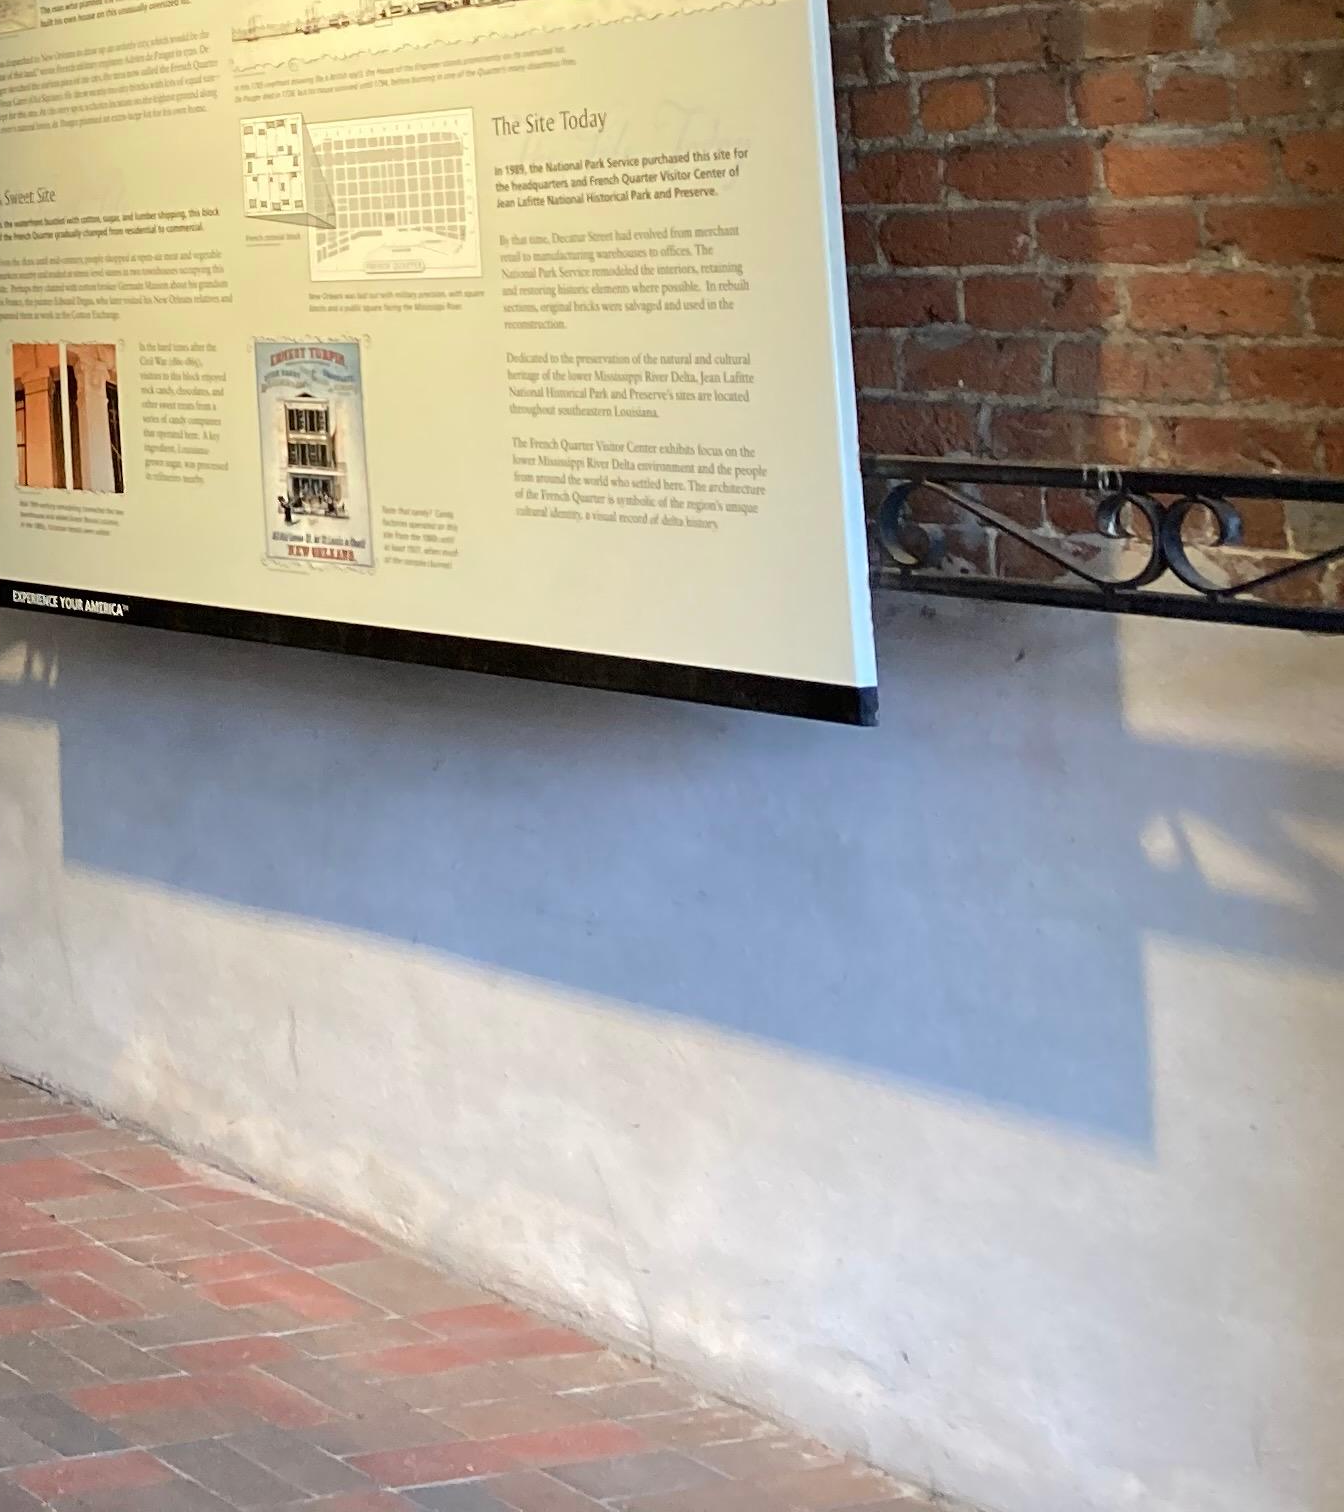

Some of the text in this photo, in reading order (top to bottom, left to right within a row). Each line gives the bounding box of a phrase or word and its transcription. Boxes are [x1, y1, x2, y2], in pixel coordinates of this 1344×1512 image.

[491, 107, 607, 136] The Site Today
[529, 162, 543, 173] the
[545, 159, 582, 172] National
[584, 157, 605, 169] Park
[606, 157, 639, 168] Service
[641, 151, 690, 168] purchased
[692, 151, 710, 162] this
[713, 149, 730, 160] site
[733, 147, 748, 159] for
[495, 181, 509, 192] the
[511, 179, 568, 192] headquarters
[570, 175, 587, 188] and
[589, 173, 619, 186] French
[621, 173, 657, 186] Quarter
[659, 169, 690, 181] Visitor
[693, 168, 726, 179] Center
[3, 189, 35, 205] Sweet
[36, 187, 56, 203] Site
[496, 187, 717, 208] Jean Lafitte National Historical Park and Preserve.
[288, 544, 310, 559] NEW
[13, 589, 59, 608] EXPERIENCE
[60, 596, 83, 612] YOUR
